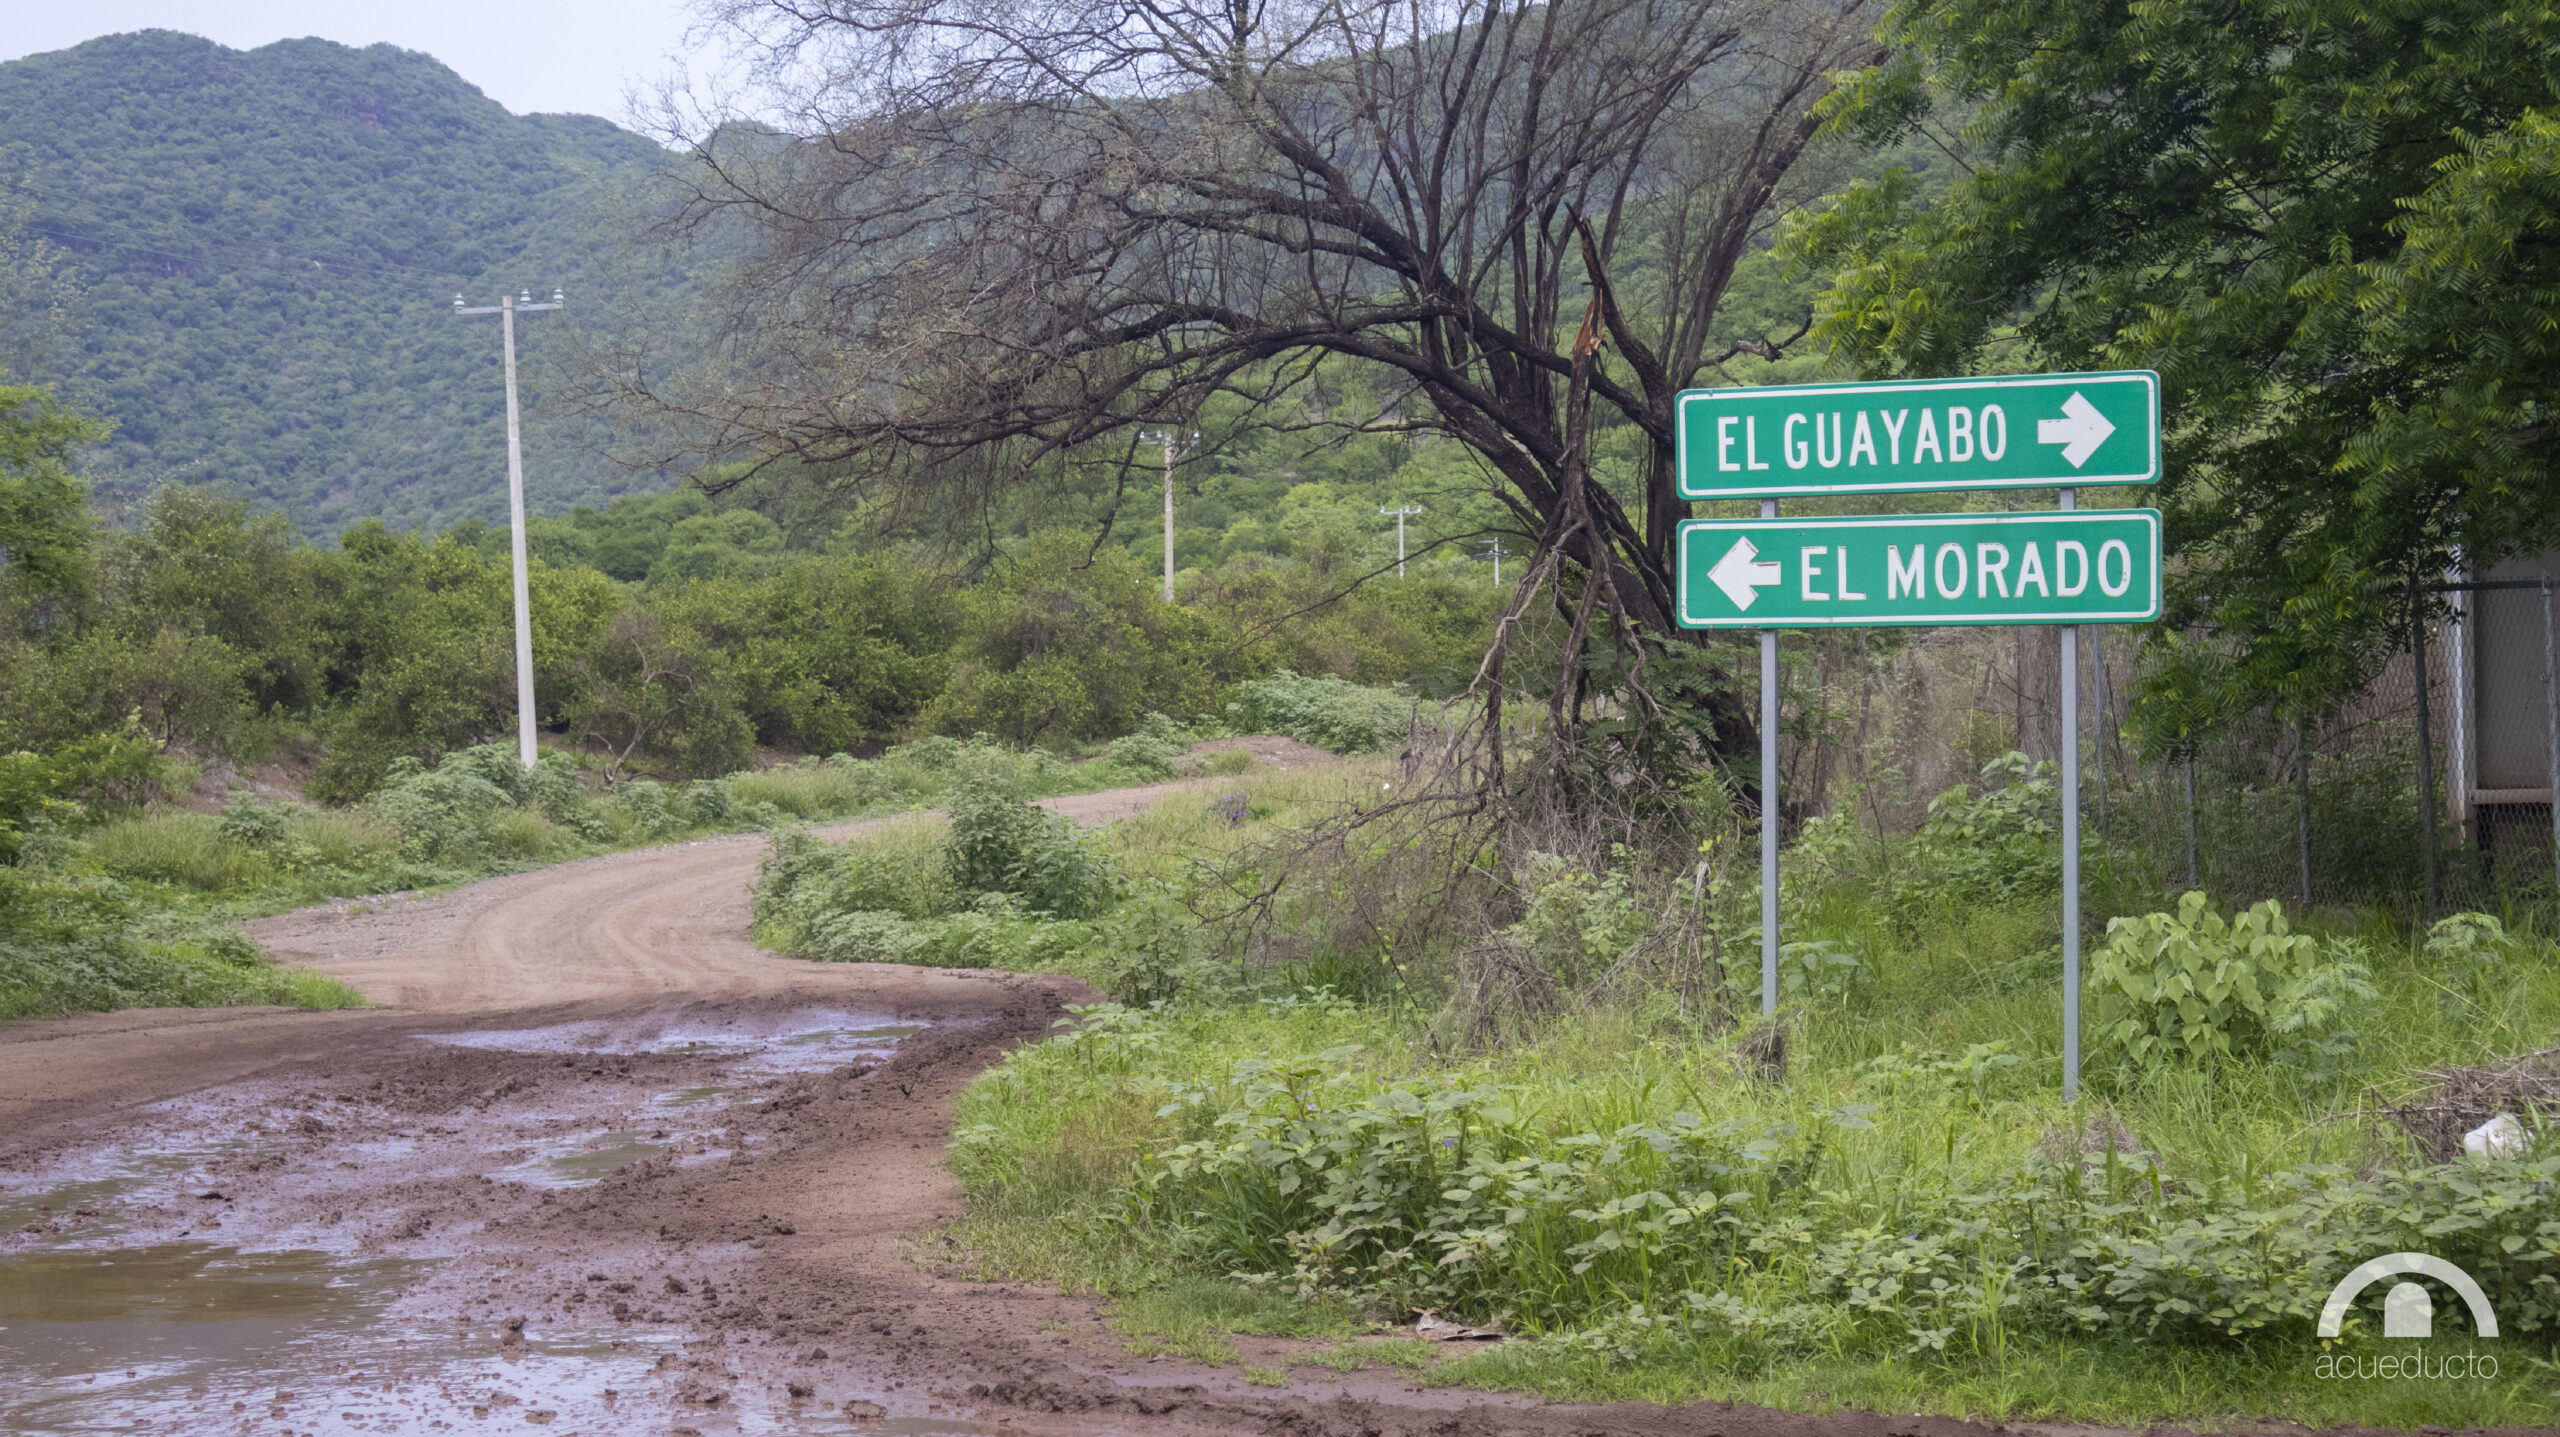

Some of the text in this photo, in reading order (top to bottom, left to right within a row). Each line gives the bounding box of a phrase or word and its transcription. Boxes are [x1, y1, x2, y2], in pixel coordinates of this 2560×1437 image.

[1717, 403, 2007, 472] EL GUAYABO
[1801, 539, 2132, 601] EL MORADO
